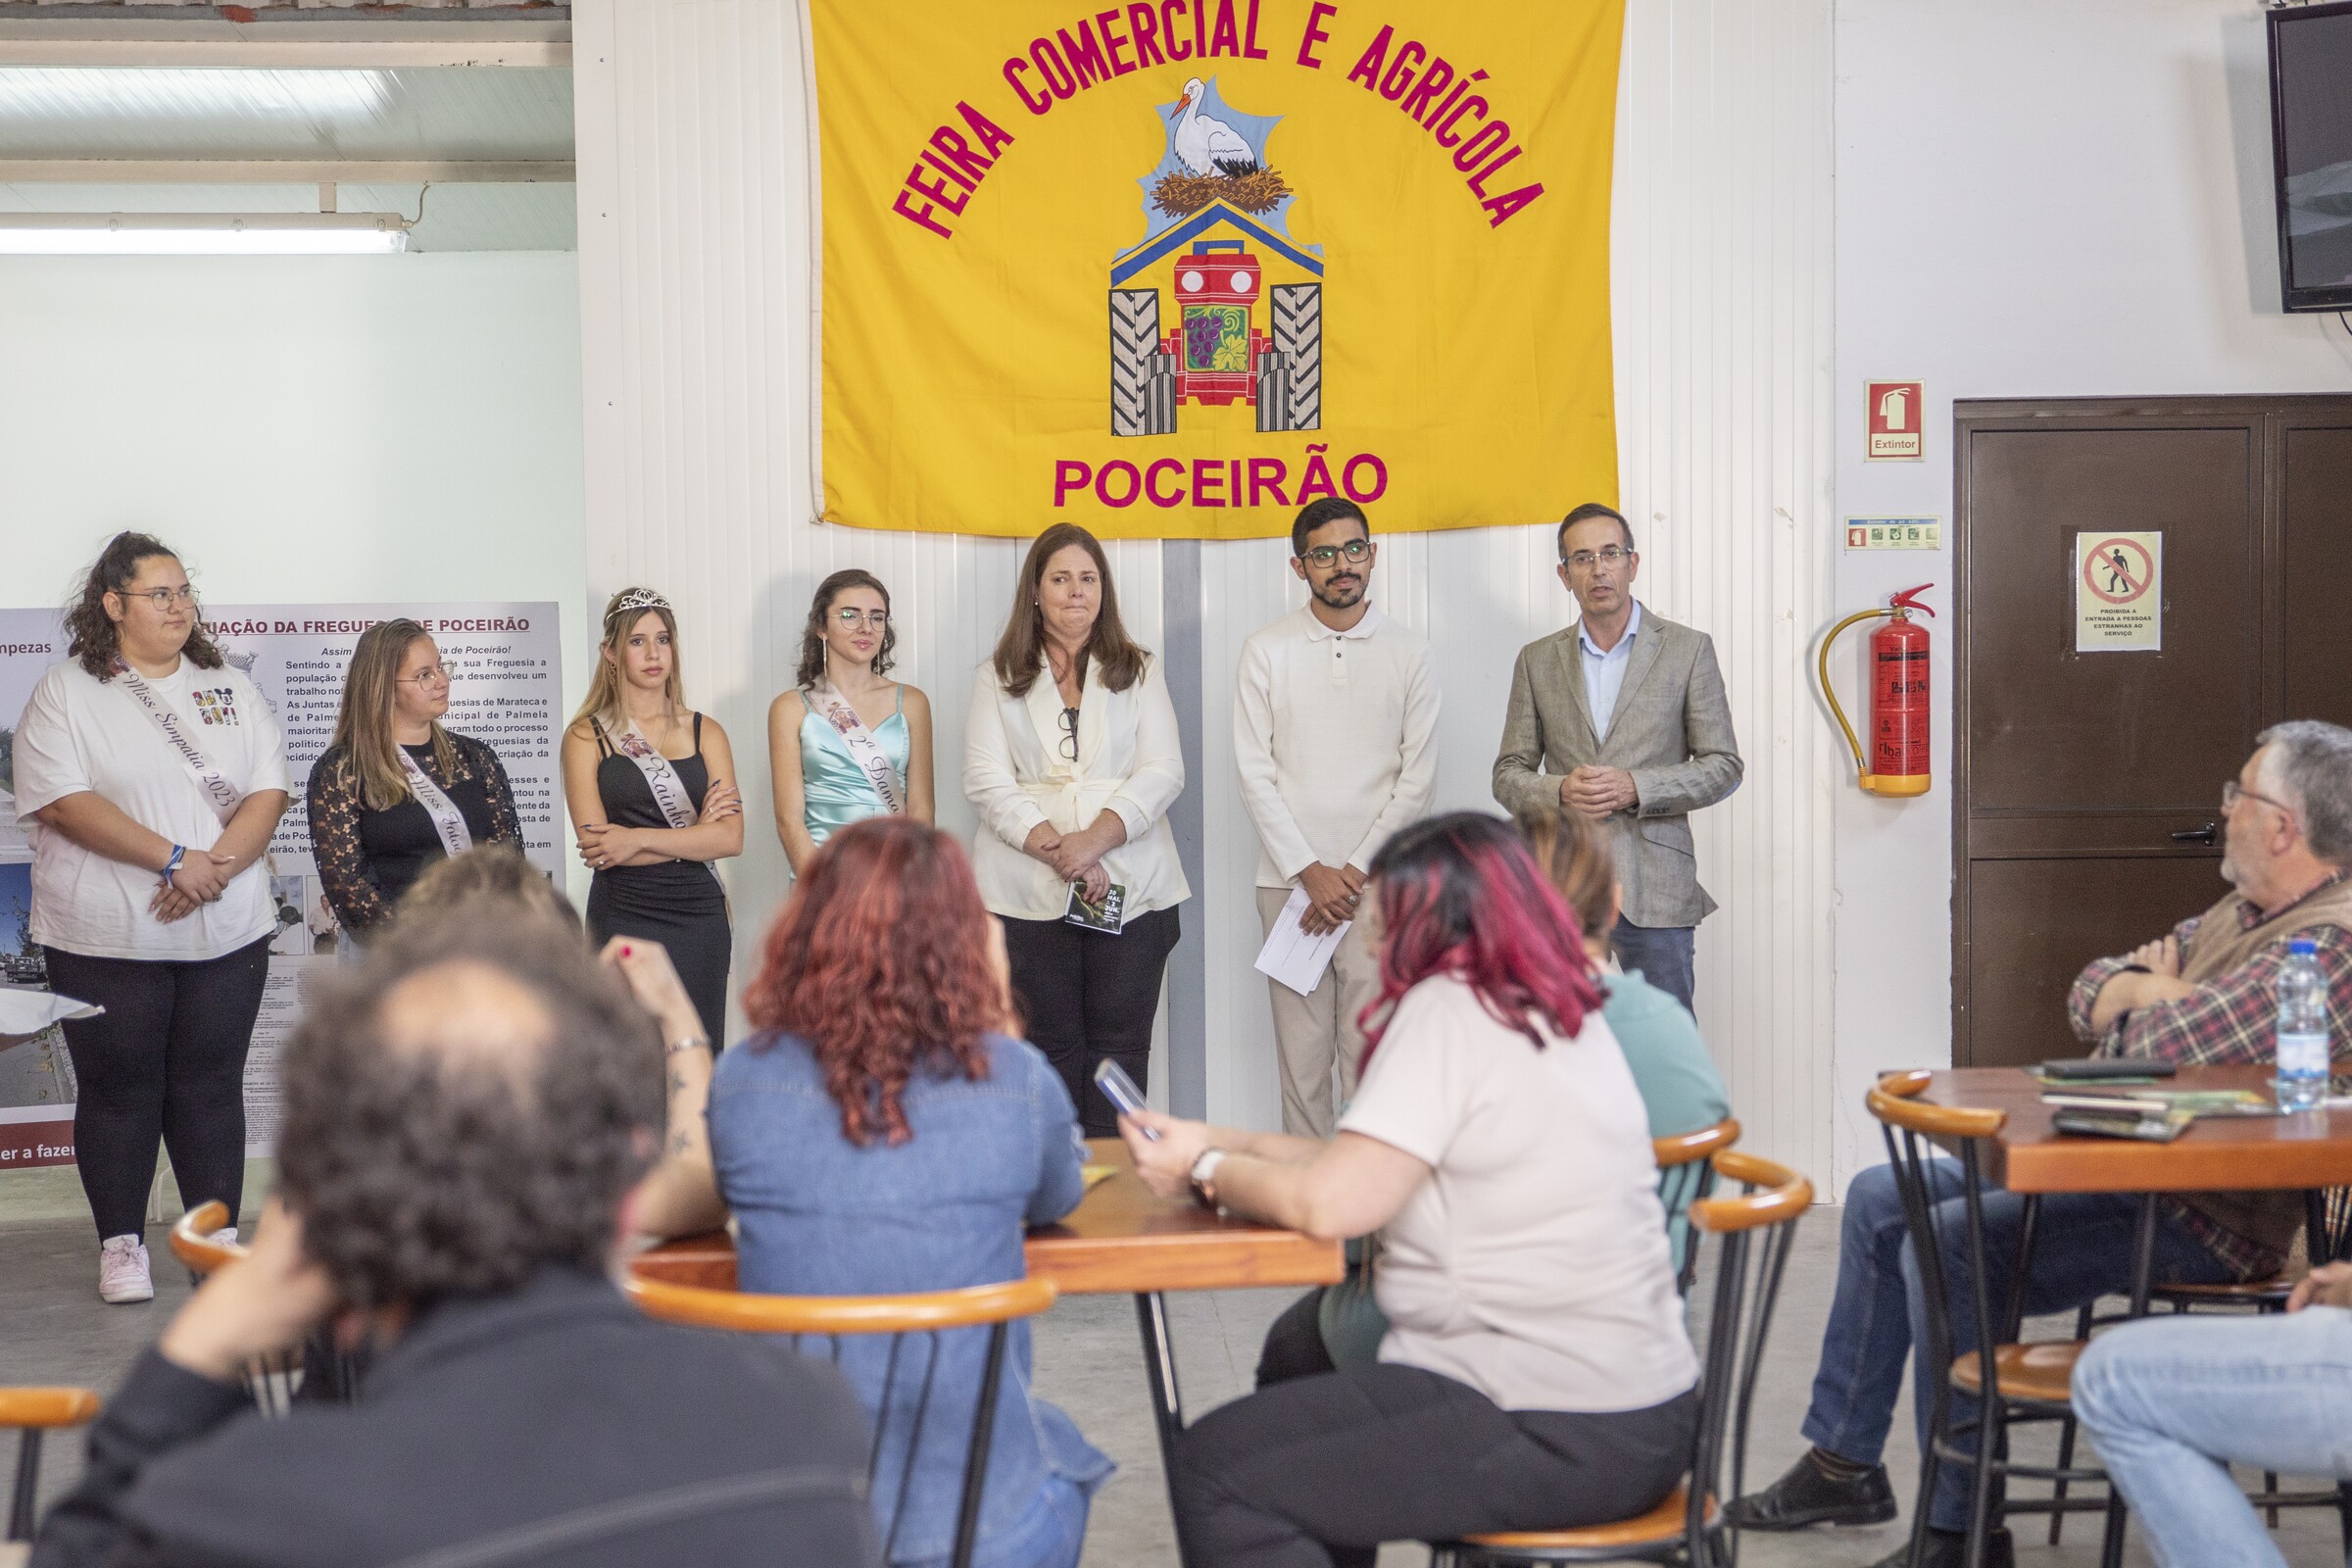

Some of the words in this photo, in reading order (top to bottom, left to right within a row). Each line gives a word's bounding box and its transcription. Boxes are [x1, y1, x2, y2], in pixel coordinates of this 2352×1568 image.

[892, 100, 1015, 240] FEIRA
[1002, 0, 1268, 116] COMERCIAL
[1297, 1, 1338, 70] E
[1346, 24, 1544, 229] AGRÍCOLA
[1875, 439, 1916, 449] Extintor
[1054, 443, 1388, 509] POCEIRÃO
[274, 620, 298, 633] DA
[304, 619, 383, 633] FREGUE
[439, 616, 530, 631] POCEIRÃO
[321, 647, 352, 656] Assim
[466, 646, 512, 655] Poceirão!
[285, 661, 330, 669] Sentindo
[487, 659, 535, 668] Freguesia
[286, 673, 337, 684] população
[287, 713, 300, 722] de
[122, 673, 157, 710] Miss
[155, 712, 206, 771] Simpatia
[202, 771, 236, 808] 2023
[288, 740, 326, 750] político
[498, 750, 533, 760] criação
[864, 756, 900, 813] Dama
[411, 773, 444, 811] Miss
[0, 1149, 19, 1160] er
[23, 1149, 32, 1158] a
